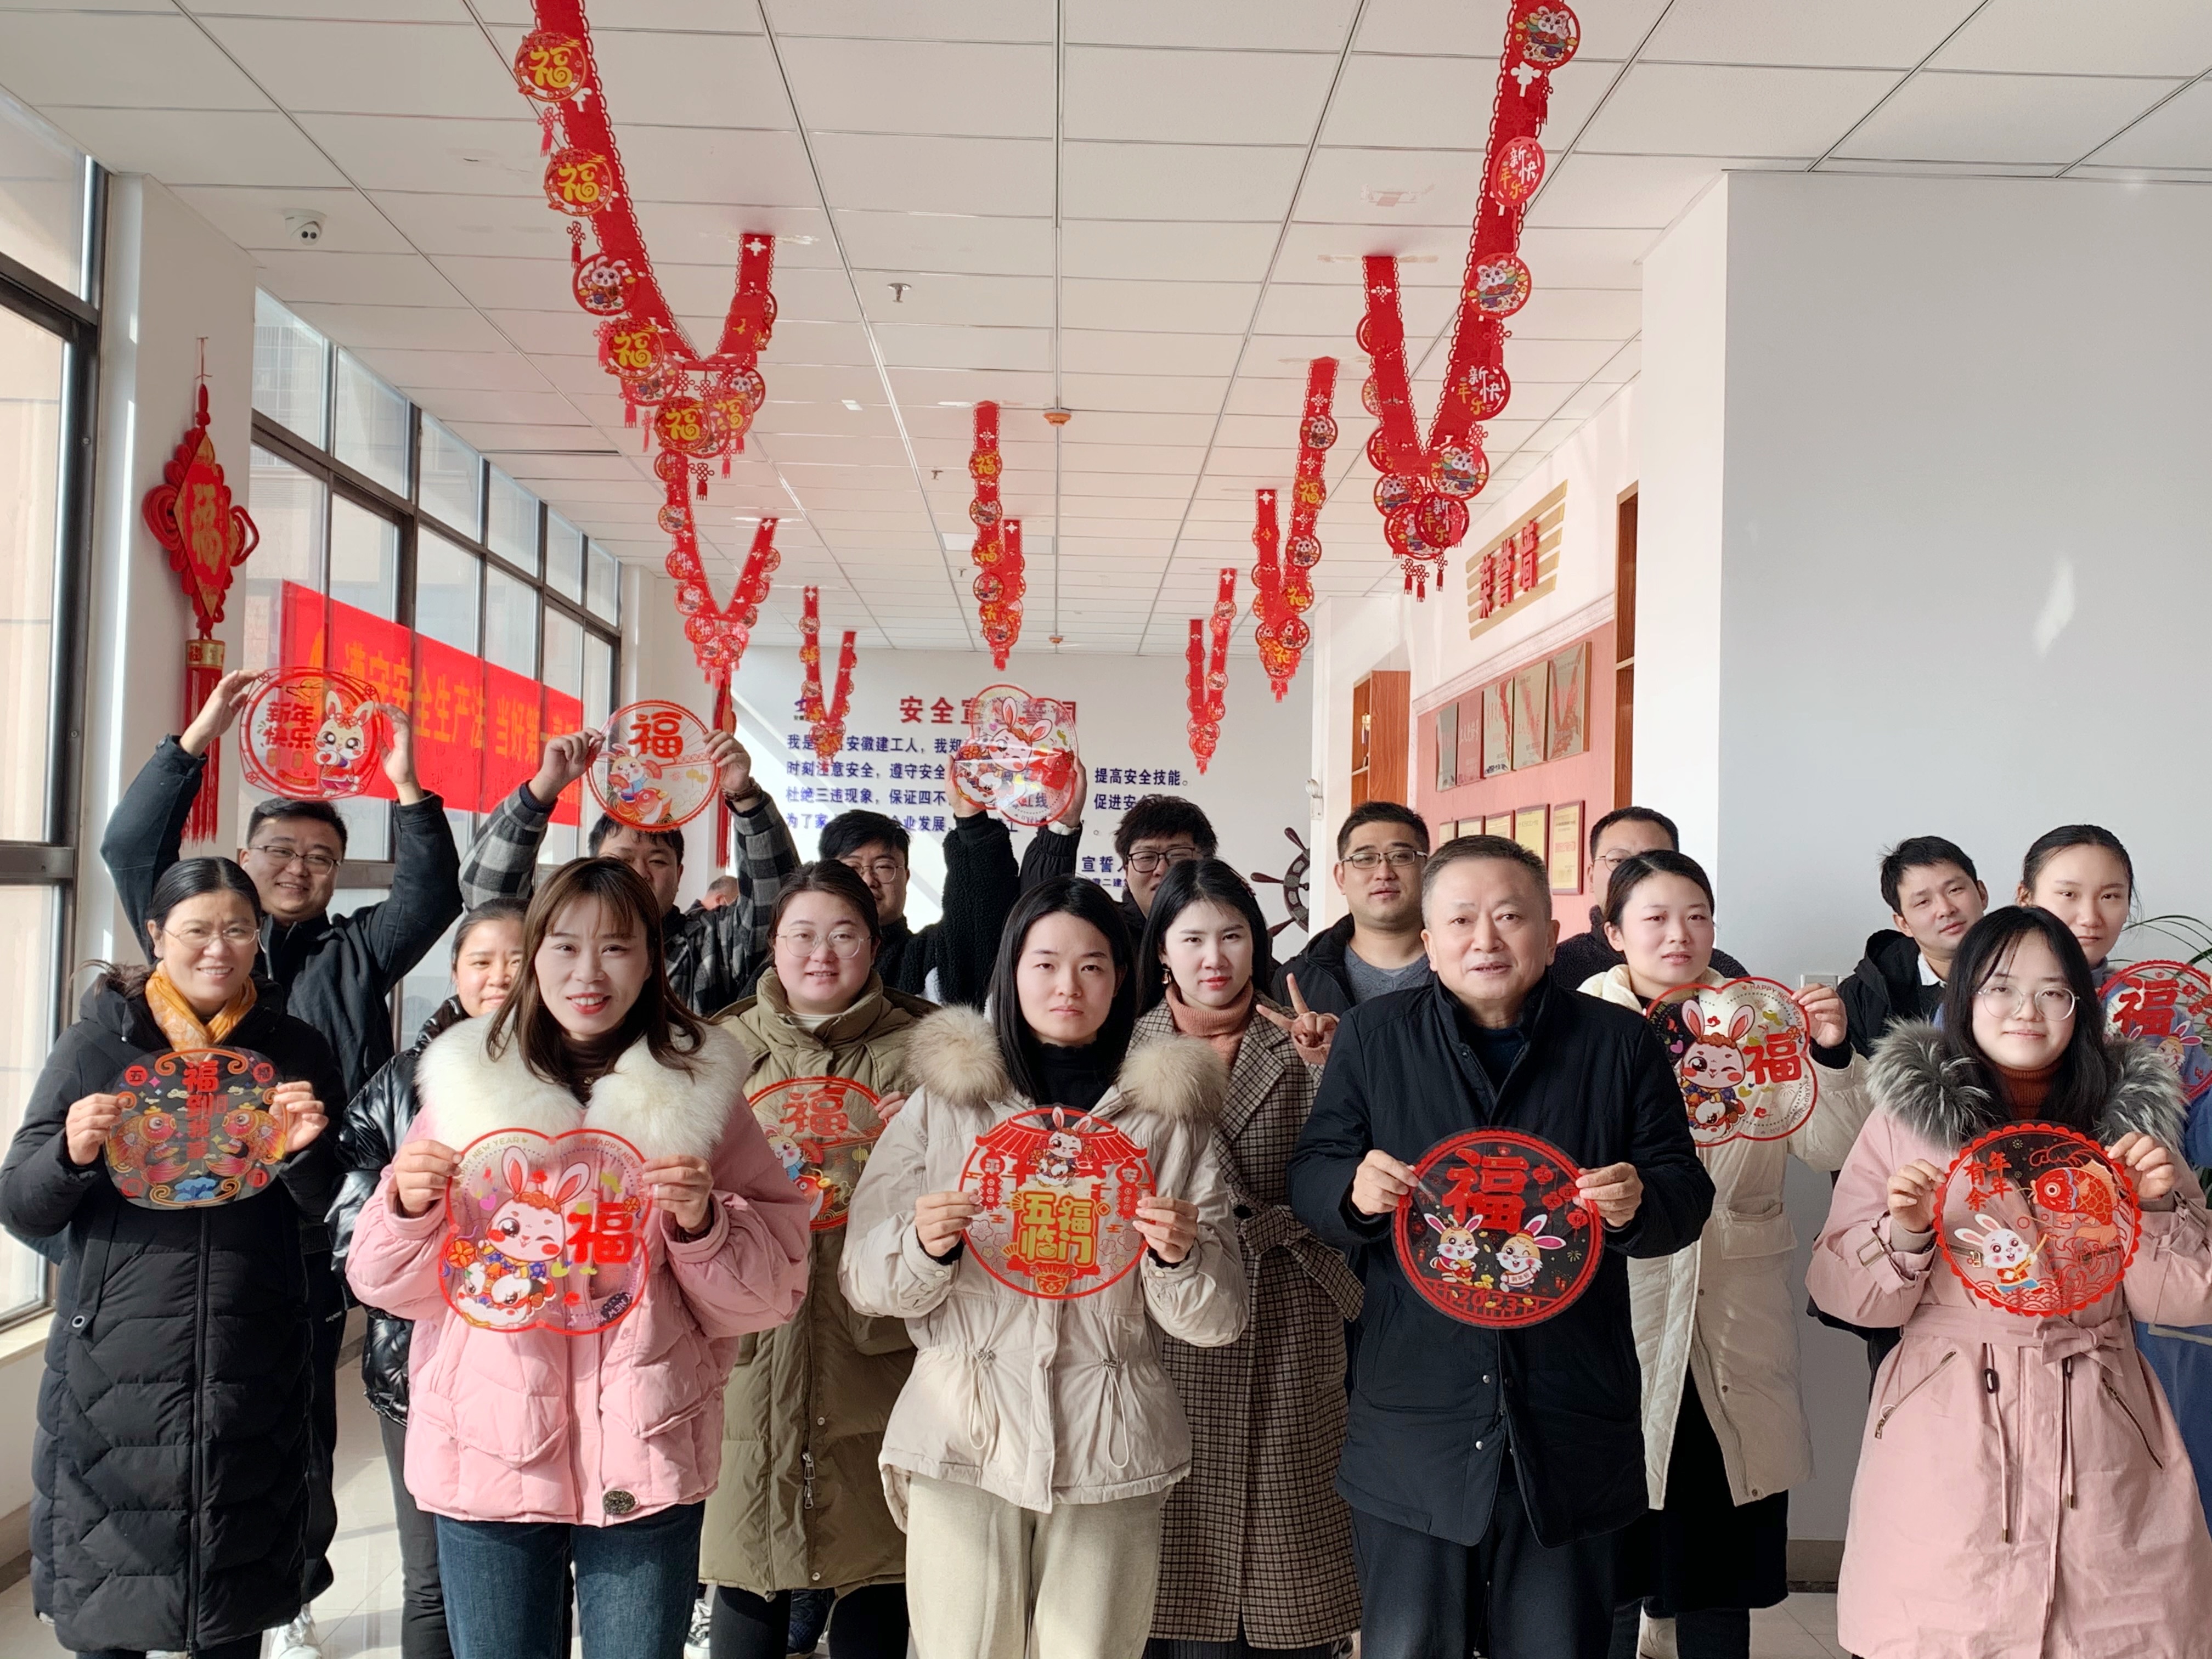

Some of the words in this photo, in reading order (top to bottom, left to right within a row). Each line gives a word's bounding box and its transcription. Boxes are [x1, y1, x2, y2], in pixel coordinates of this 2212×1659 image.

[529, 45, 573, 88] 福
[558, 162, 600, 203] 福
[613, 331, 652, 368] 福
[665, 407, 700, 441] 福
[975, 455, 996, 475] 福
[1300, 482, 1319, 504] 福
[1479, 519, 1539, 619] 荣誉墙
[266, 701, 314, 726] 新年
[263, 726, 311, 748] 快乐
[628, 711, 683, 758] 福
[2113, 977, 2179, 1036] 福
[1742, 1033, 1802, 1085] 福
[779, 1087, 848, 1136] 福
[472, 1143, 490, 1159] NEW
[493, 1137, 520, 1146] YEAR
[1442, 1148, 1529, 1234] 福
[1023, 1193, 1092, 1233] 五福
[567, 1203, 634, 1265] 福
[1022, 1224, 1092, 1263] 临门
[608, 1299, 627, 1318] NEW
